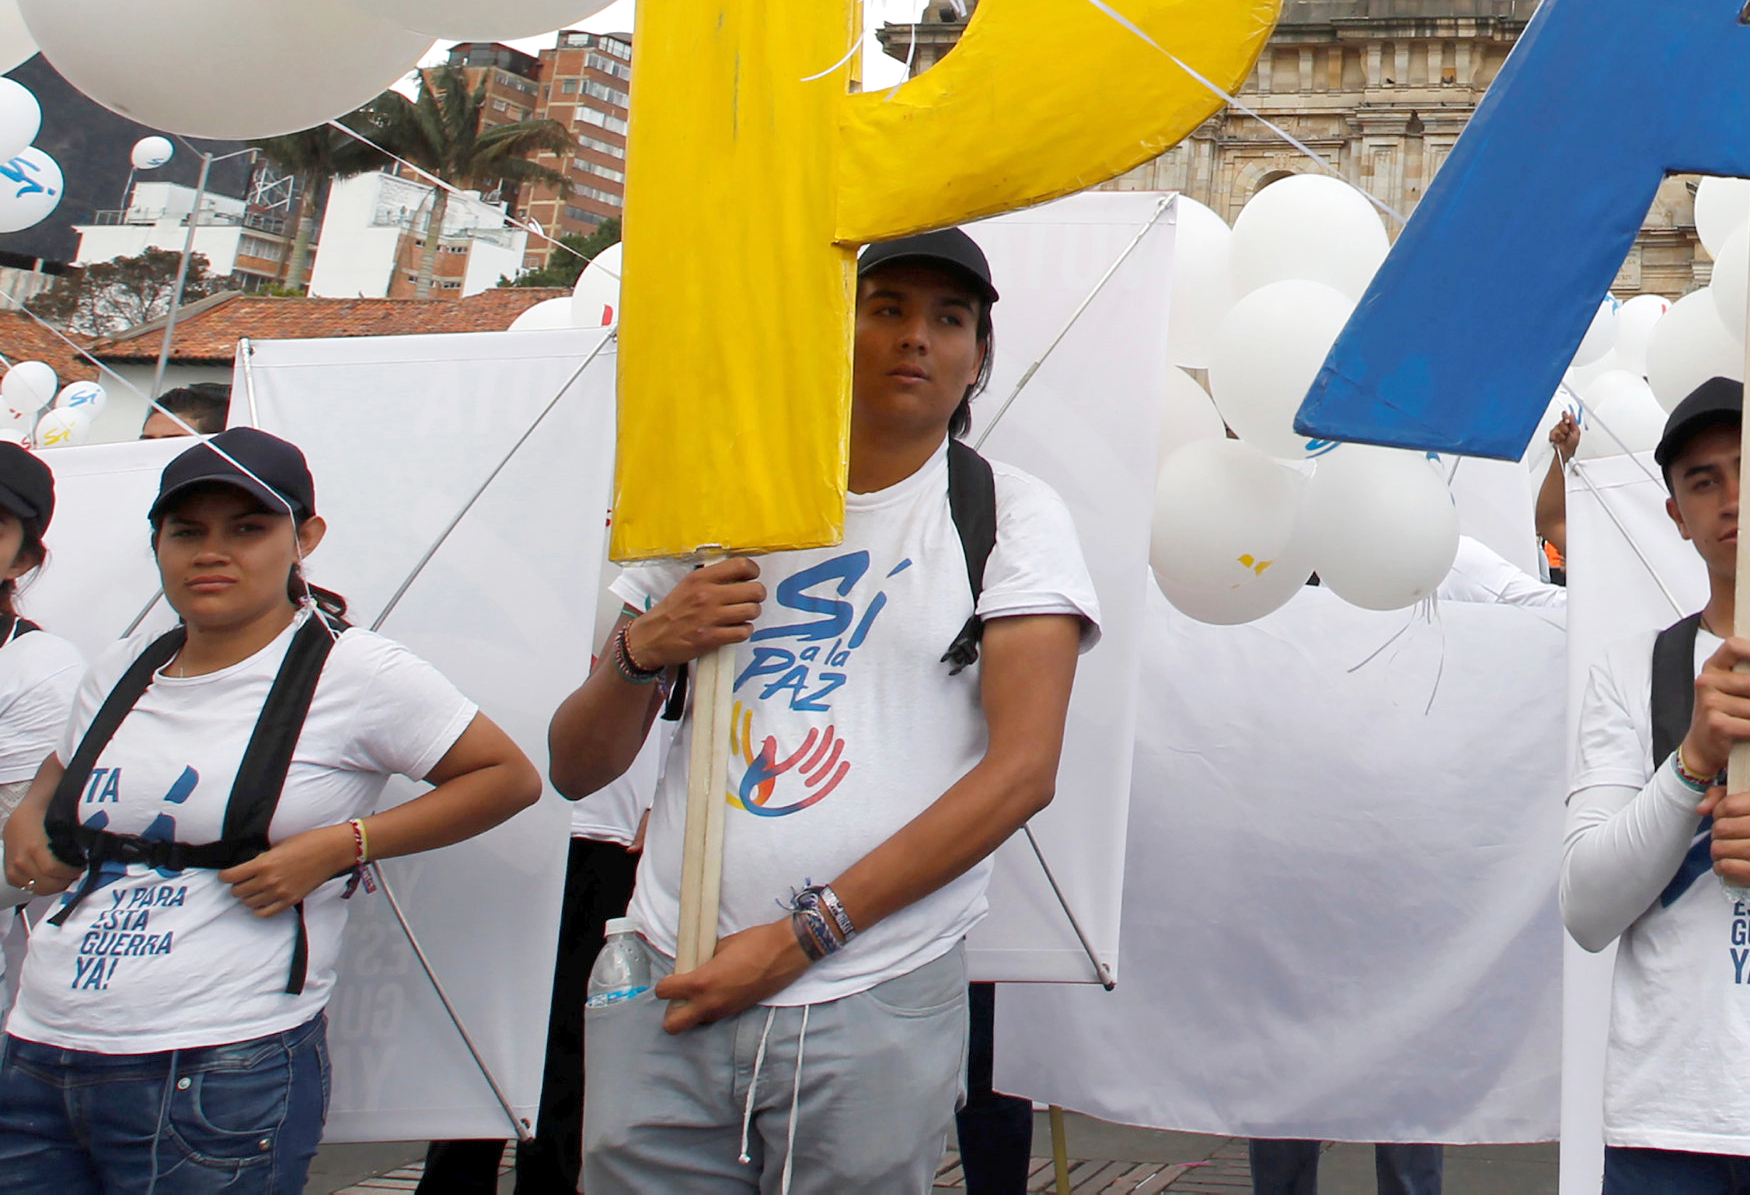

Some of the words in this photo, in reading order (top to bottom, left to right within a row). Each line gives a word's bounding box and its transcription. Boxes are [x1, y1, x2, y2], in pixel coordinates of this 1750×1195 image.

[799, 646, 821, 662] a
[732, 647, 848, 712] PAZ
[83, 767, 122, 803] TA
[111, 889, 128, 910] Y
[126, 885, 188, 909] PARA
[89, 909, 150, 931] ESTA
[80, 931, 174, 956] GUERRA
[71, 955, 119, 990] YA!
